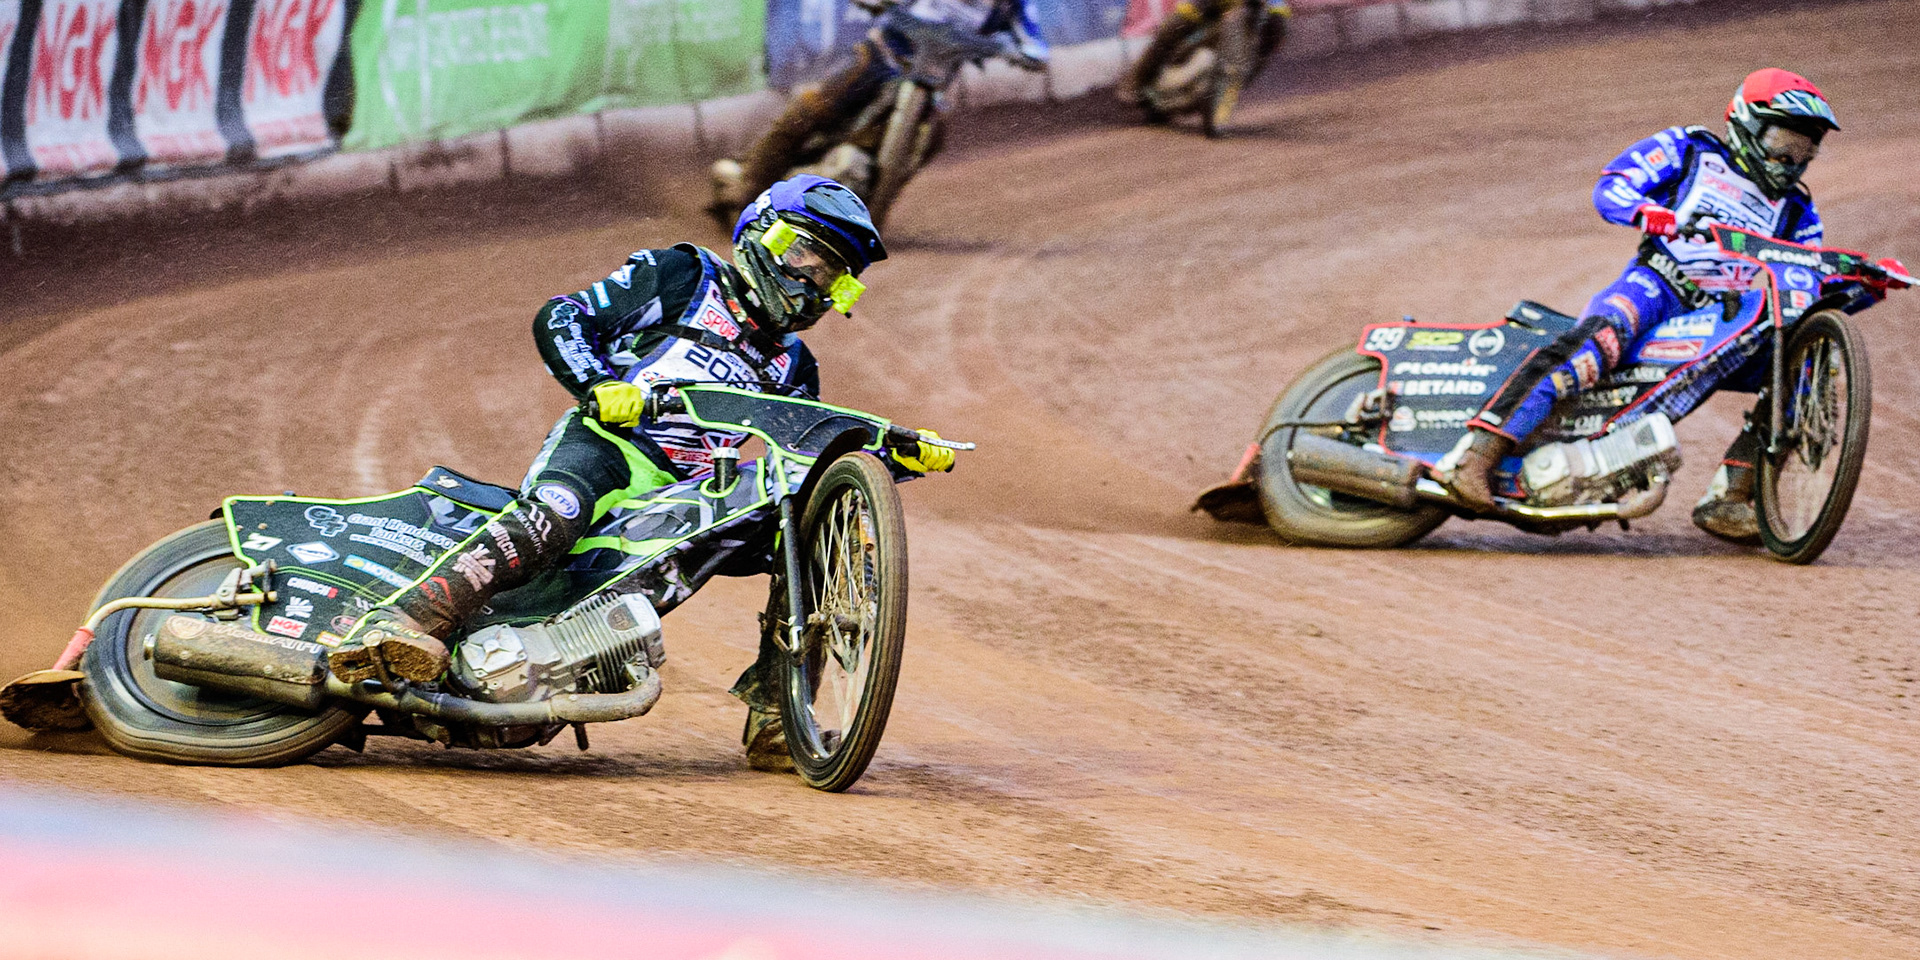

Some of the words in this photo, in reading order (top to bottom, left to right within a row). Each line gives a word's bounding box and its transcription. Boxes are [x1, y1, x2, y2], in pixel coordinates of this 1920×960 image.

[26, 2, 116, 126] NGK
[134, 0, 223, 115] NGK
[702, 309, 740, 342] SPOR
[1364, 327, 1407, 351] 99
[1403, 380, 1487, 396] BETARD
[270, 616, 306, 634] NGK
